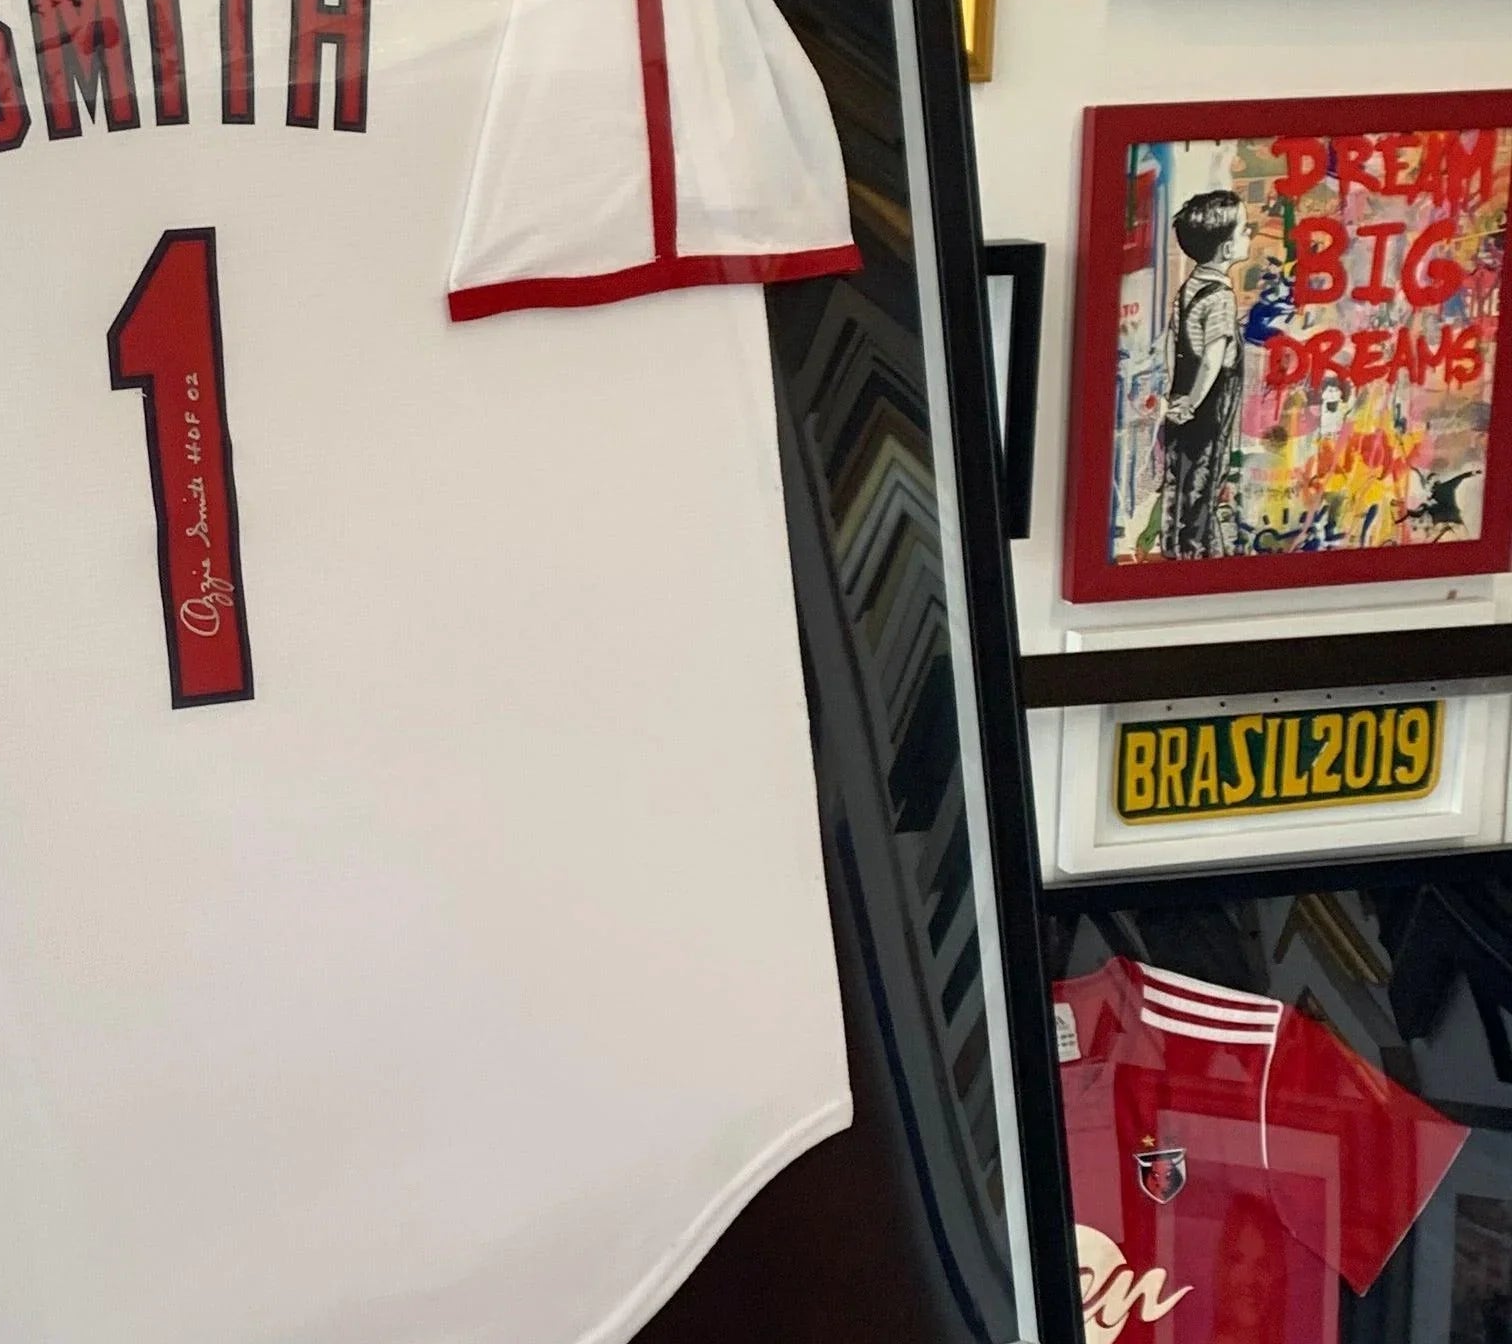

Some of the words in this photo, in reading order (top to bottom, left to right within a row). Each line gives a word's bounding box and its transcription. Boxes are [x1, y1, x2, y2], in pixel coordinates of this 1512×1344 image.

[1271, 130, 1497, 211] DREAM
[1291, 216, 1465, 308] BIG
[185, 372, 200, 401] 02
[1264, 325, 1485, 391] DREAMS
[106, 226, 255, 709] 1
[184, 411, 202, 464] HOF
